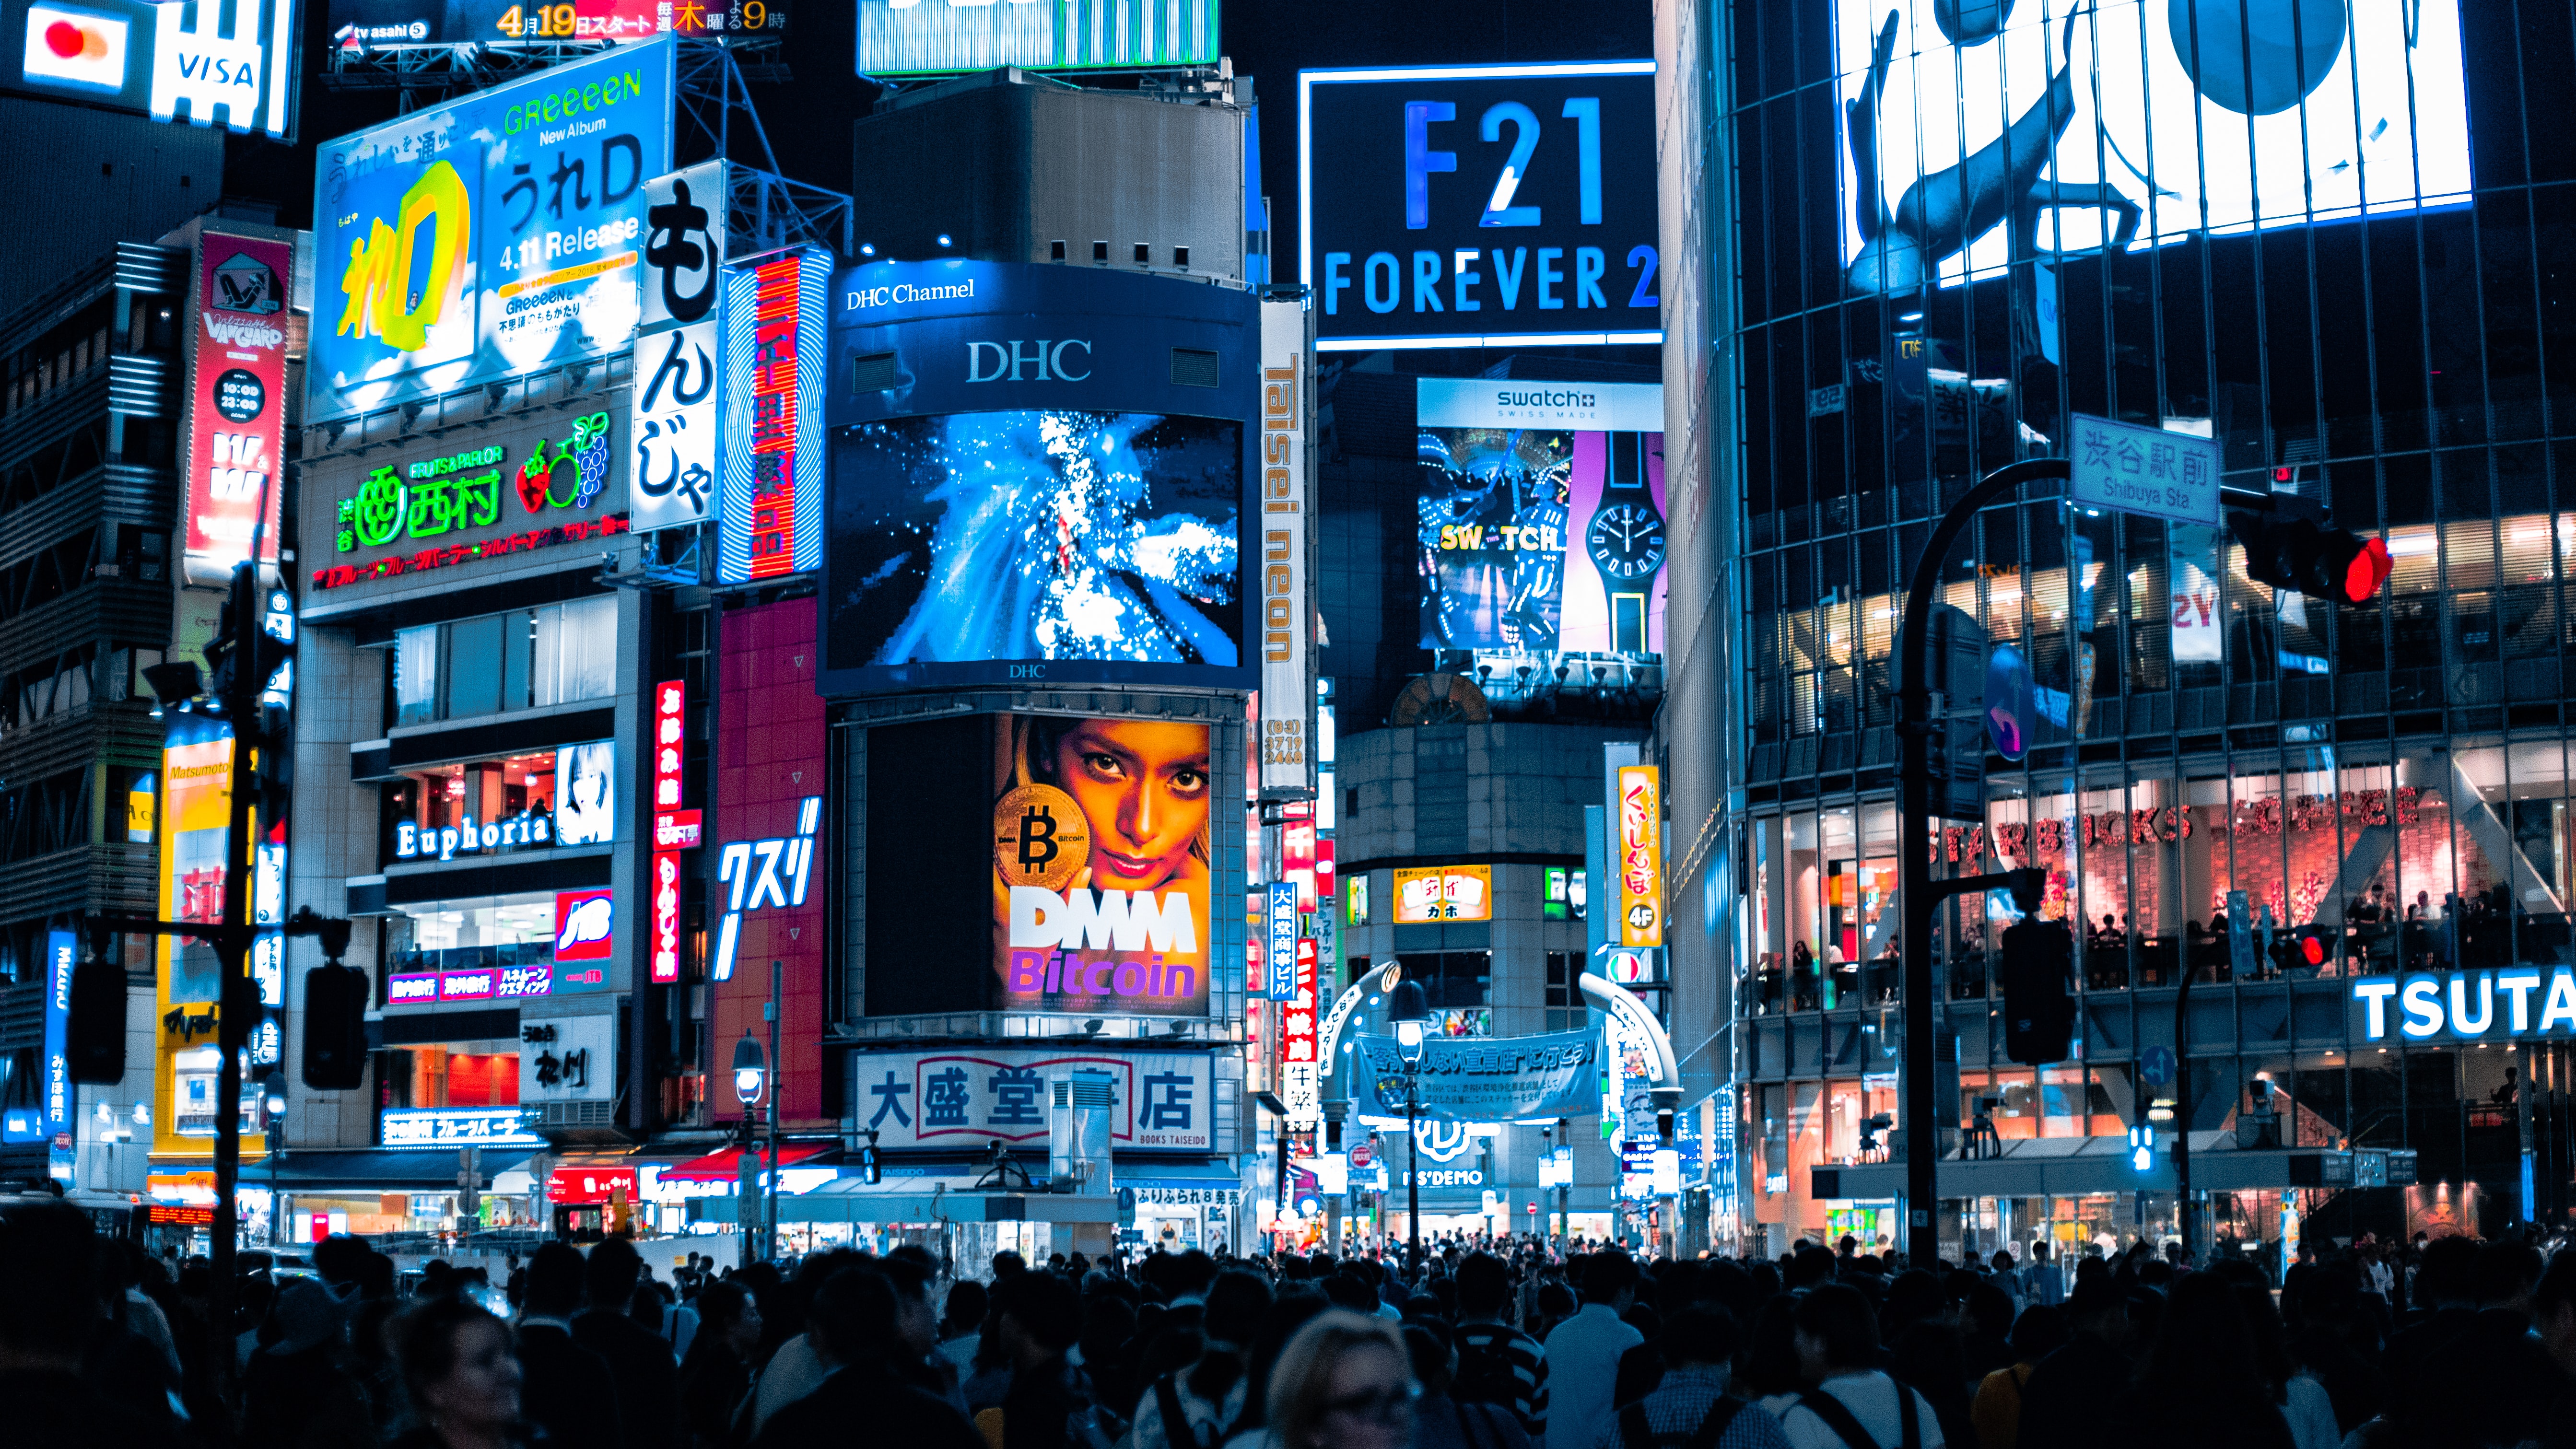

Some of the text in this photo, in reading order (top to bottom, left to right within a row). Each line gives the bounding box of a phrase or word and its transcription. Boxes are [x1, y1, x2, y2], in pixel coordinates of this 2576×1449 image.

[354, 26, 368, 38] tv
[371, 25, 407, 38] asahi
[178, 52, 254, 89] VISA
[540, 117, 606, 146] New Album
[1405, 97, 1602, 229] F21
[501, 133, 643, 240] うれD
[500, 217, 639, 271] 4.11 Release
[847, 279, 974, 311] DHC Channel
[1325, 245, 1607, 315] FOREVER
[202, 312, 283, 351] VANGUARD
[640, 178, 719, 515] もんじゃ
[965, 339, 1092, 383] DHC
[223, 383, 259, 397] 10:00
[1497, 390, 1580, 408] swatch
[1498, 410, 1596, 419] SWISS MADE
[2084, 430, 2208, 487] 渋谷駅前
[407, 468, 501, 538] 西村
[1264, 353, 1299, 664] Taisei neon
[2104, 478, 2194, 510] Shibuya Sta.
[338, 498, 354, 553] 渋谷
[1009, 664, 1046, 679] DHC
[1265, 736, 1302, 751] 3719
[1267, 720, 1300, 735] (03)
[170, 761, 230, 780] Matsumoto
[1265, 750, 1303, 765] 2468
[396, 811, 549, 861] Euphoria
[718, 836, 813, 912] クスリ
[1009, 885, 1197, 953] DMM
[1628, 907, 1653, 927] 4F
[1274, 889, 1292, 994] 大盛堂商事ビル
[502, 968, 547, 982] ハネムーン
[583, 969, 602, 984] JTB
[1008, 950, 1196, 998] Bitcoin
[2355, 973, 2576, 1038] TSUTA
[1140, 1134, 1206, 1145] BOOKS TAISEIDO
[1403, 1170, 1483, 1186] IS'DEMO
